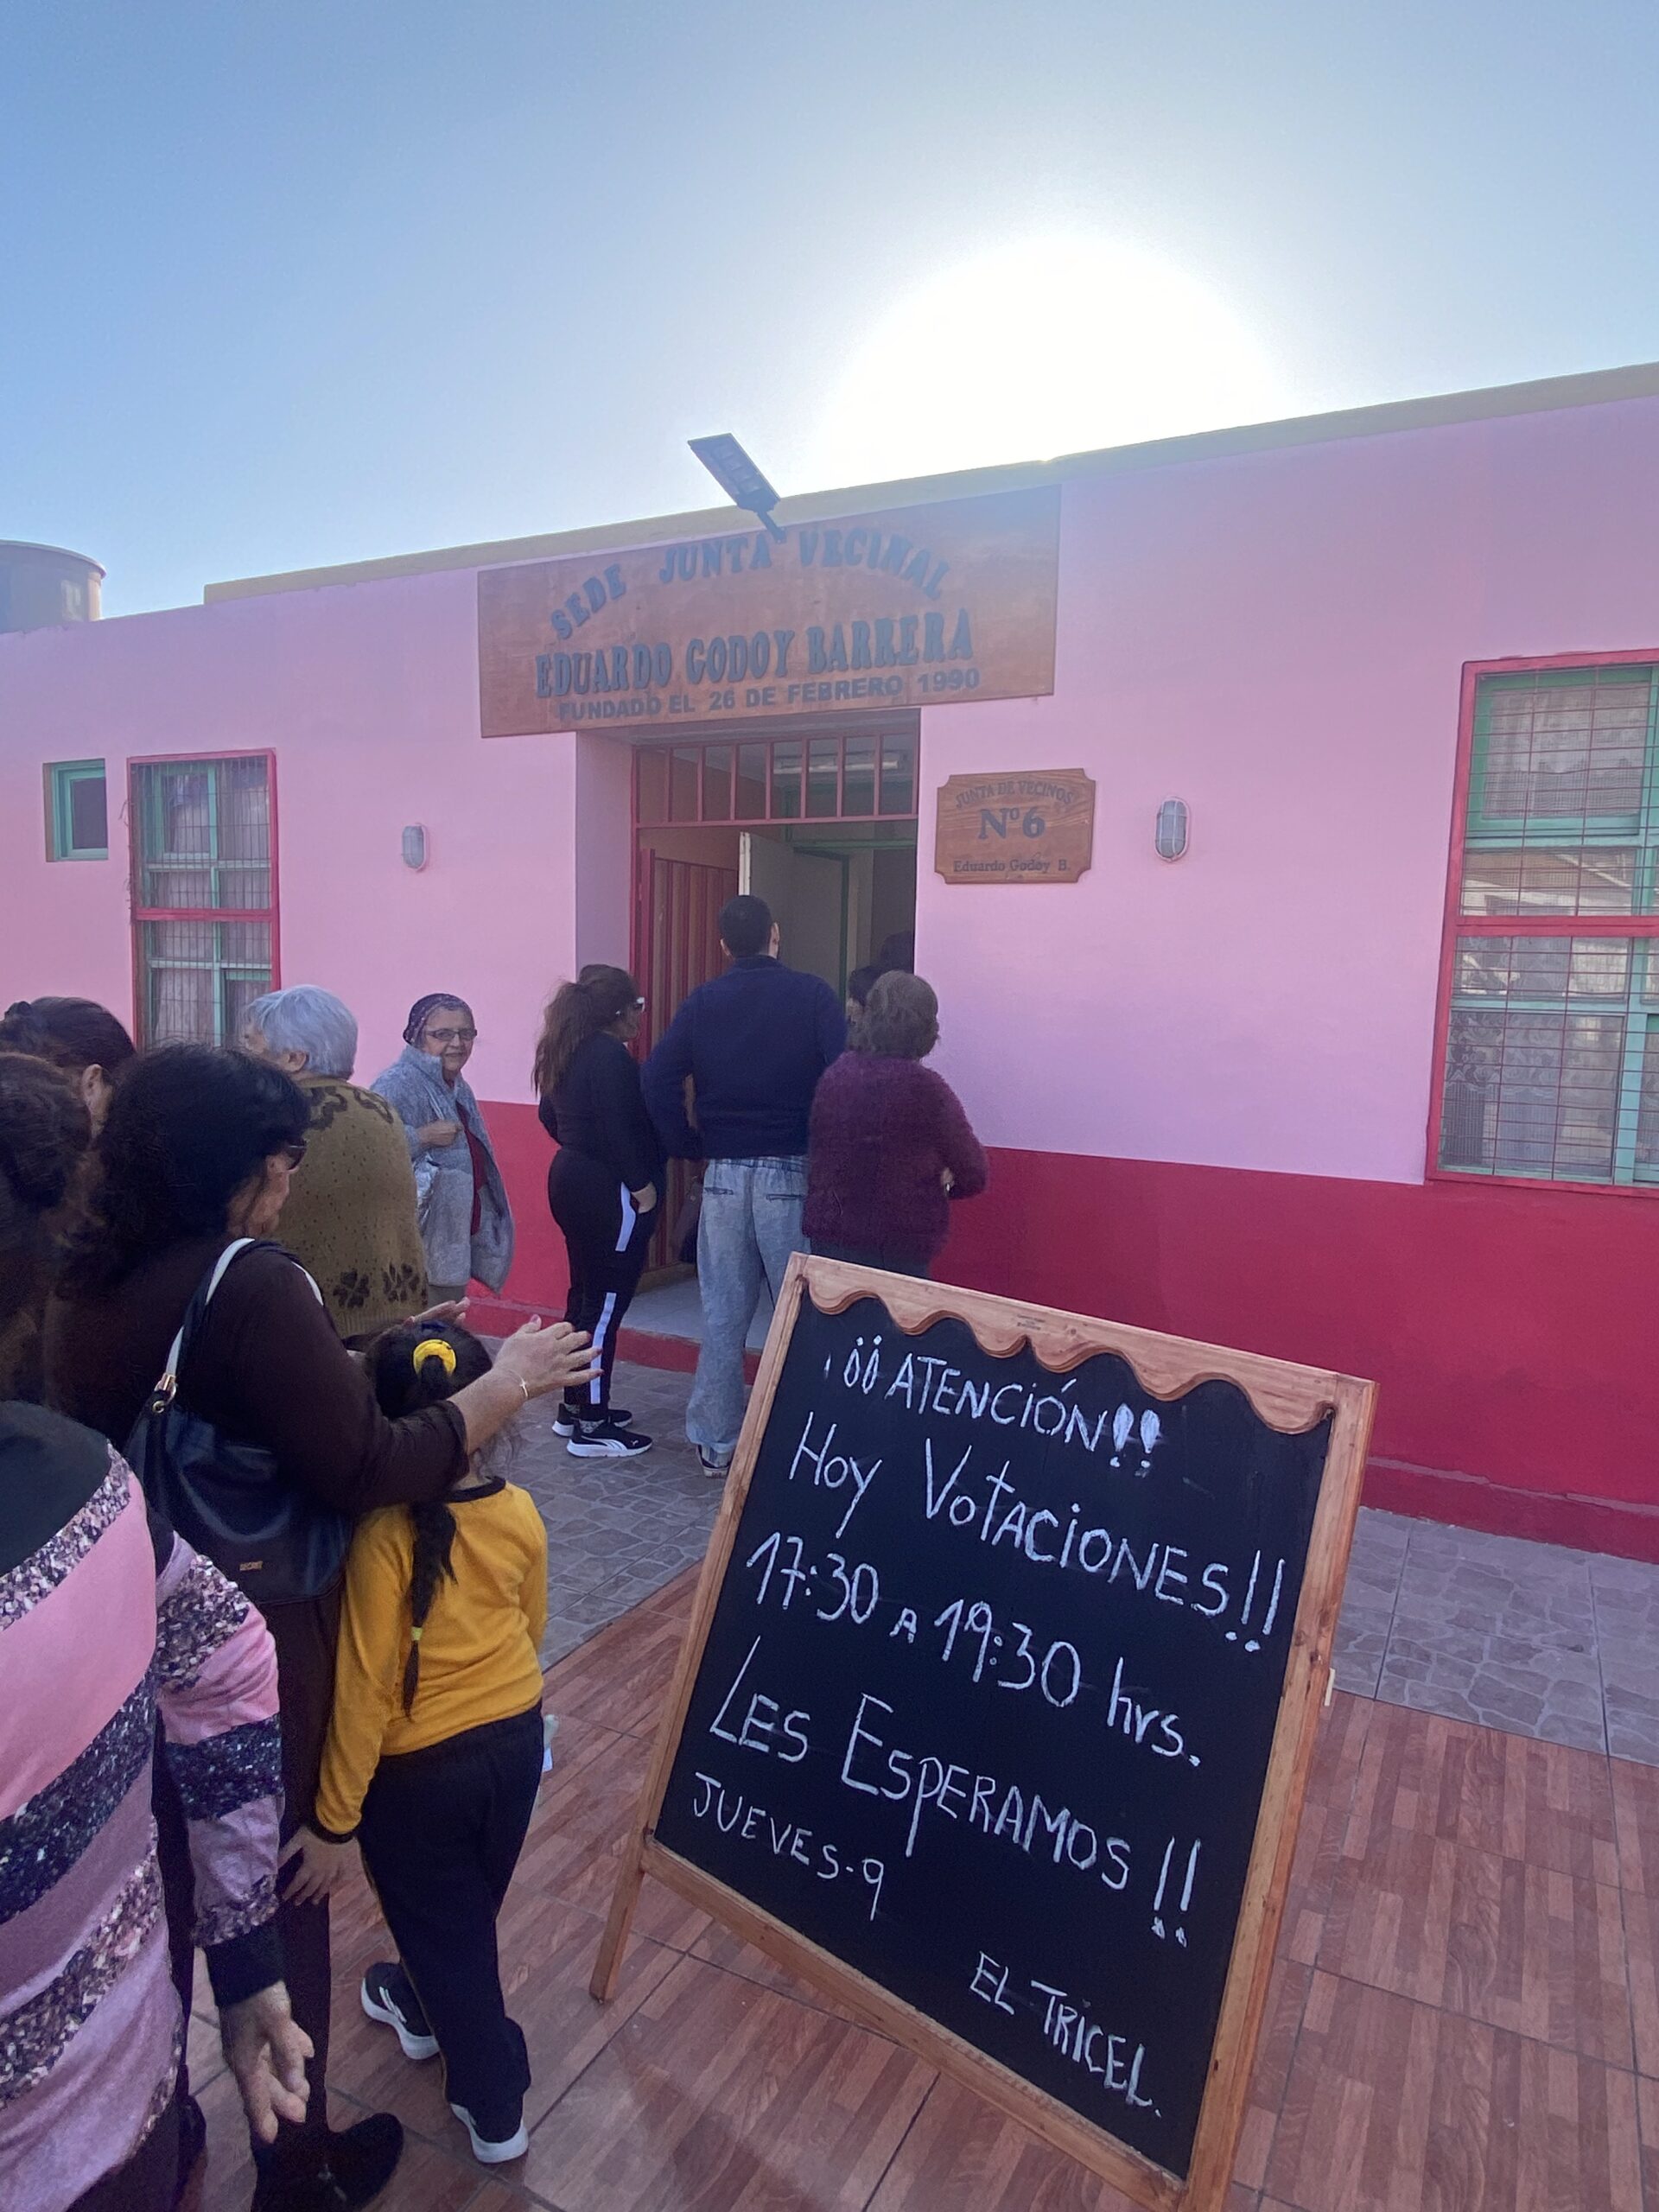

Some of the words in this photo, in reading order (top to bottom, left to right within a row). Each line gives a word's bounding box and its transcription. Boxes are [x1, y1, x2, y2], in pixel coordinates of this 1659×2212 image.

[550, 564, 626, 640] SEDE
[659, 533, 772, 583] JUNTA
[799, 528, 950, 600] VECINAL
[536, 642, 672, 696] EDUARDO
[686, 630, 795, 685] GODOY
[805, 608, 974, 674] BARRERA
[559, 696, 661, 721] FUNDADO
[670, 696, 694, 714] EL
[709, 692, 735, 712] 26
[746, 689, 775, 708] DE
[787, 676, 903, 703] FEBRERO
[918, 668, 980, 692] 1990
[956, 785, 993, 808] JUNTA
[998, 783, 1014, 795] DE
[1018, 780, 1074, 804] VECINOS
[954, 861, 1006, 873] Eduardo
[1009, 859, 1051, 874] Godoy
[747, 1531, 880, 1624] 17:30
[890, 1607, 917, 1643] A
[934, 1599, 1082, 1707] 19:30
[1107, 1656, 1201, 1767] hrs.
[969, 1951, 1015, 2016] EL
